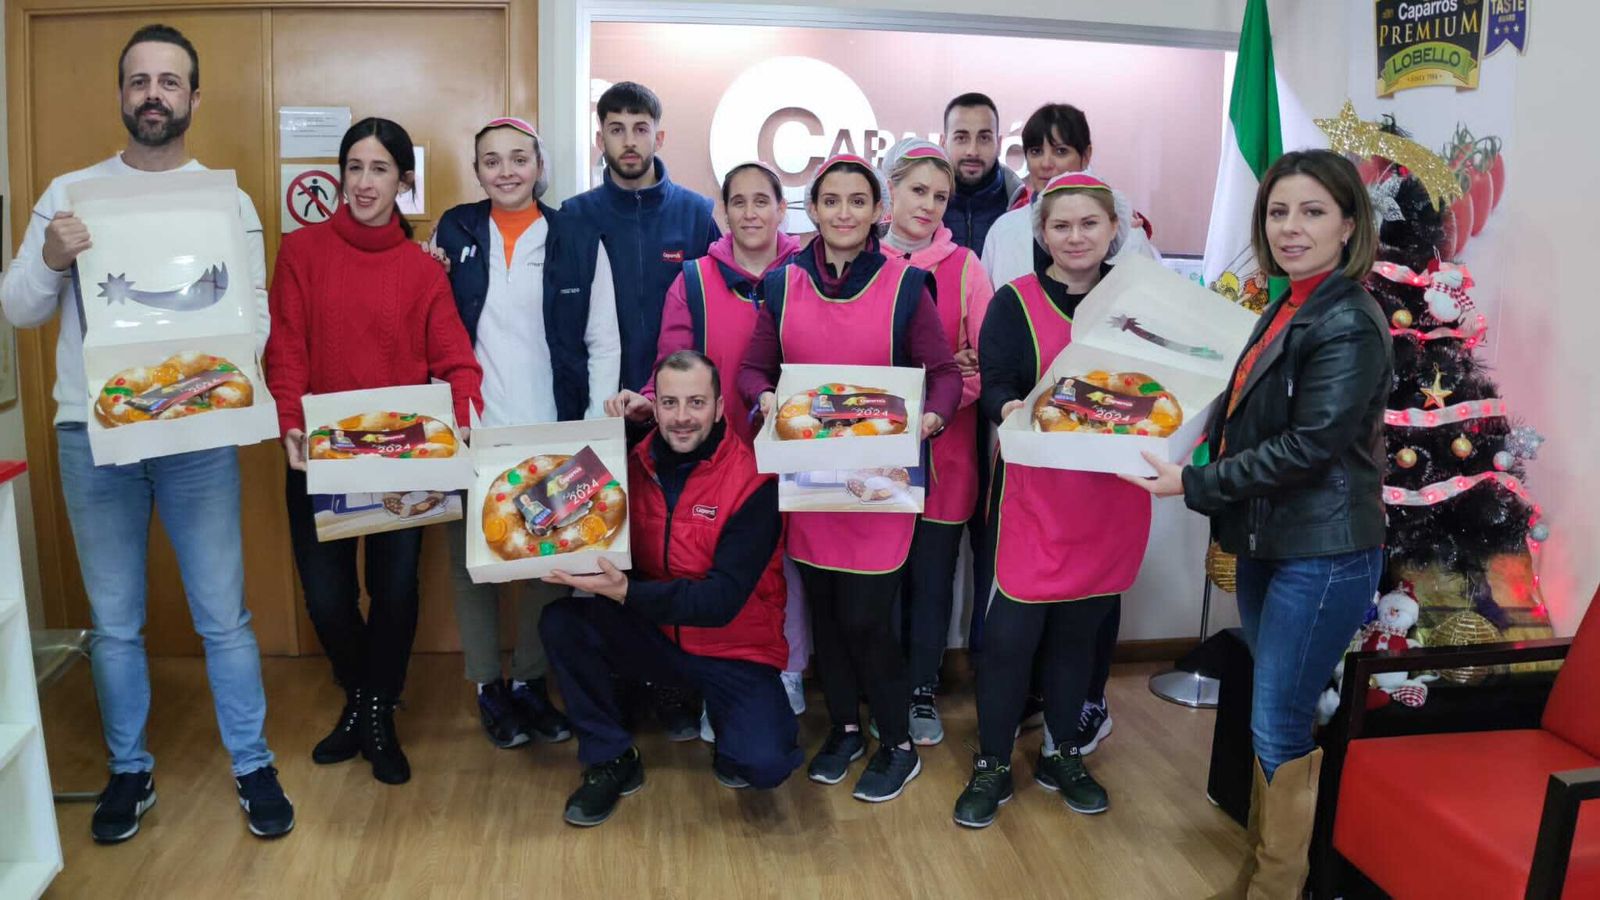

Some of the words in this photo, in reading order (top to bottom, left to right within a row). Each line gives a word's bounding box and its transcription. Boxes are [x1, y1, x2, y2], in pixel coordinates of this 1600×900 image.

[1491, 0, 1525, 15] TASTE
[1379, 8, 1479, 47] PREMIUM
[1392, 47, 1461, 74] LOBELLO
[856, 408, 888, 417] 2024
[1095, 409, 1131, 422] 2024
[377, 443, 411, 453] 2024
[569, 479, 599, 505] 2024
